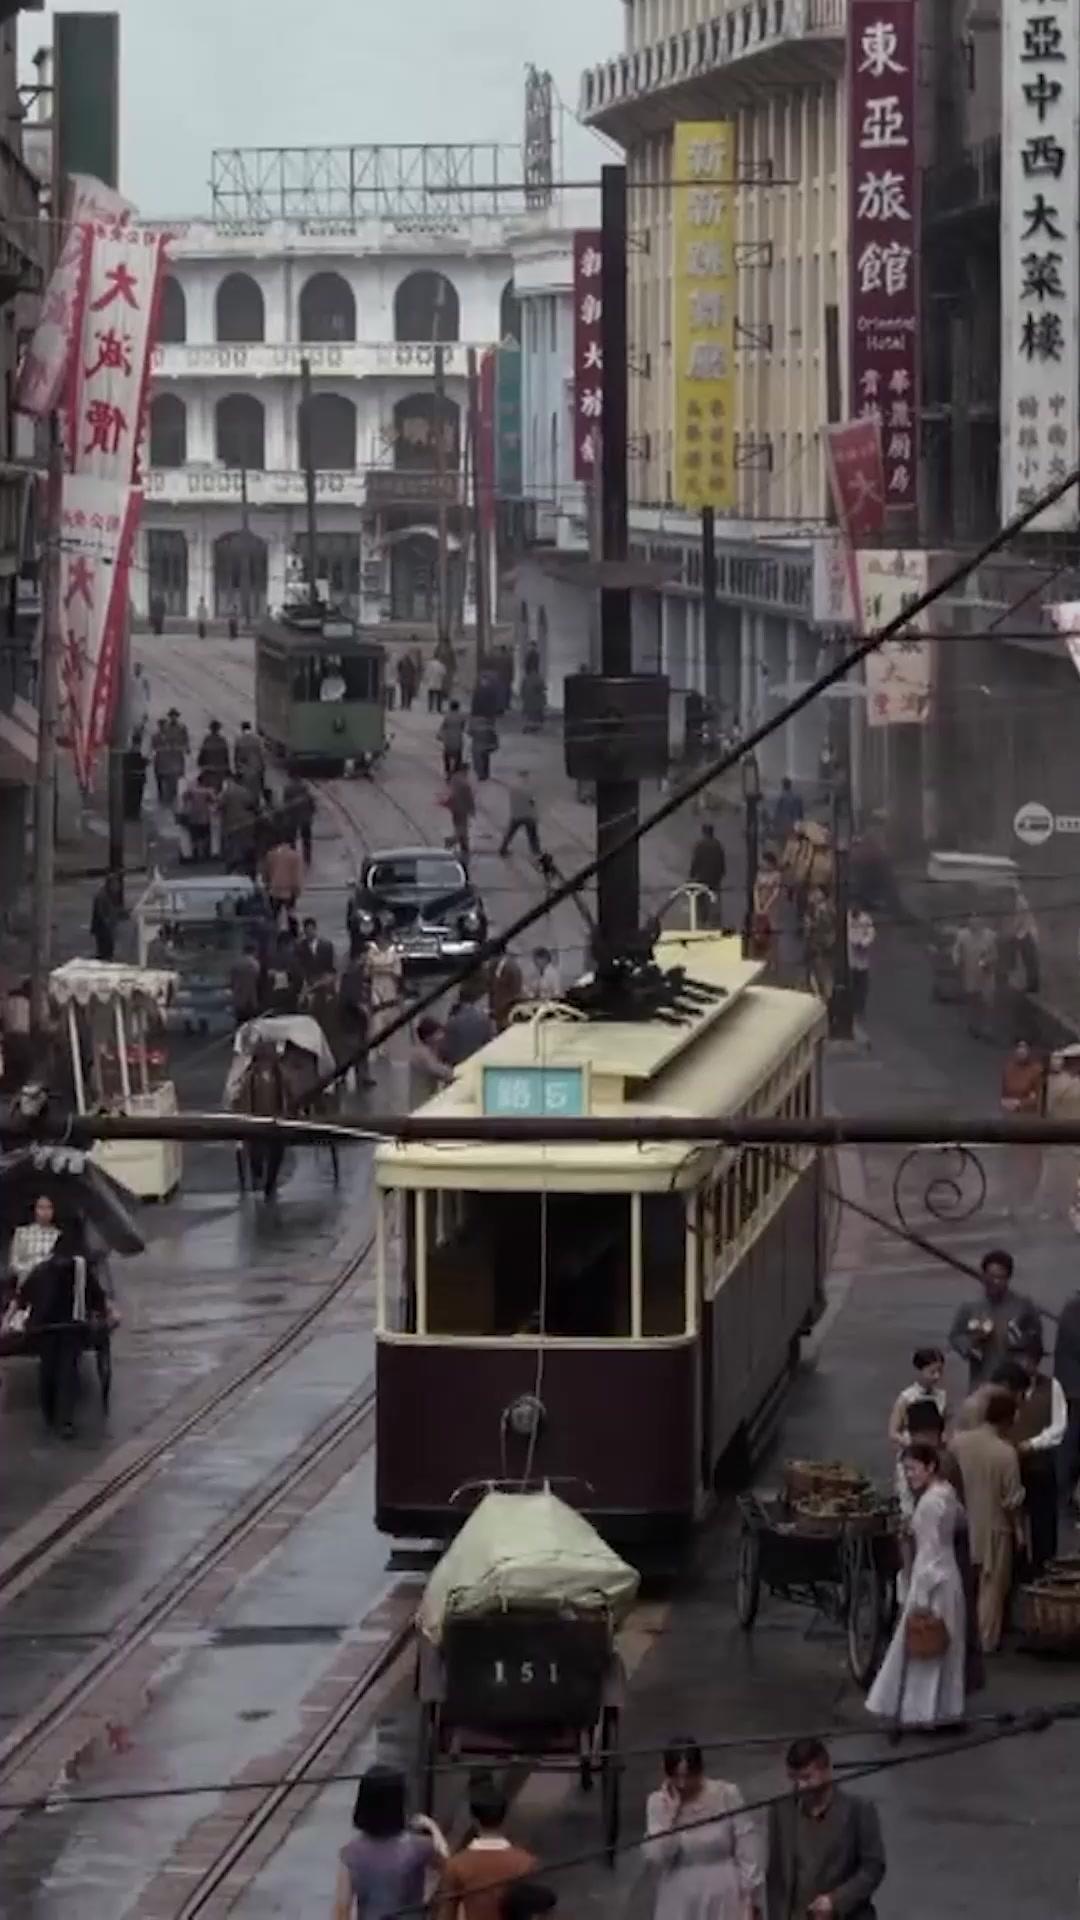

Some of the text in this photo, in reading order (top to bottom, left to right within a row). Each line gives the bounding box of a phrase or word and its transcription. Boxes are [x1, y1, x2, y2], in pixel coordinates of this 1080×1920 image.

[858, 21, 912, 297] 東亞旅館
[1018, 0, 1067, 362] 亞中西大菜樓
